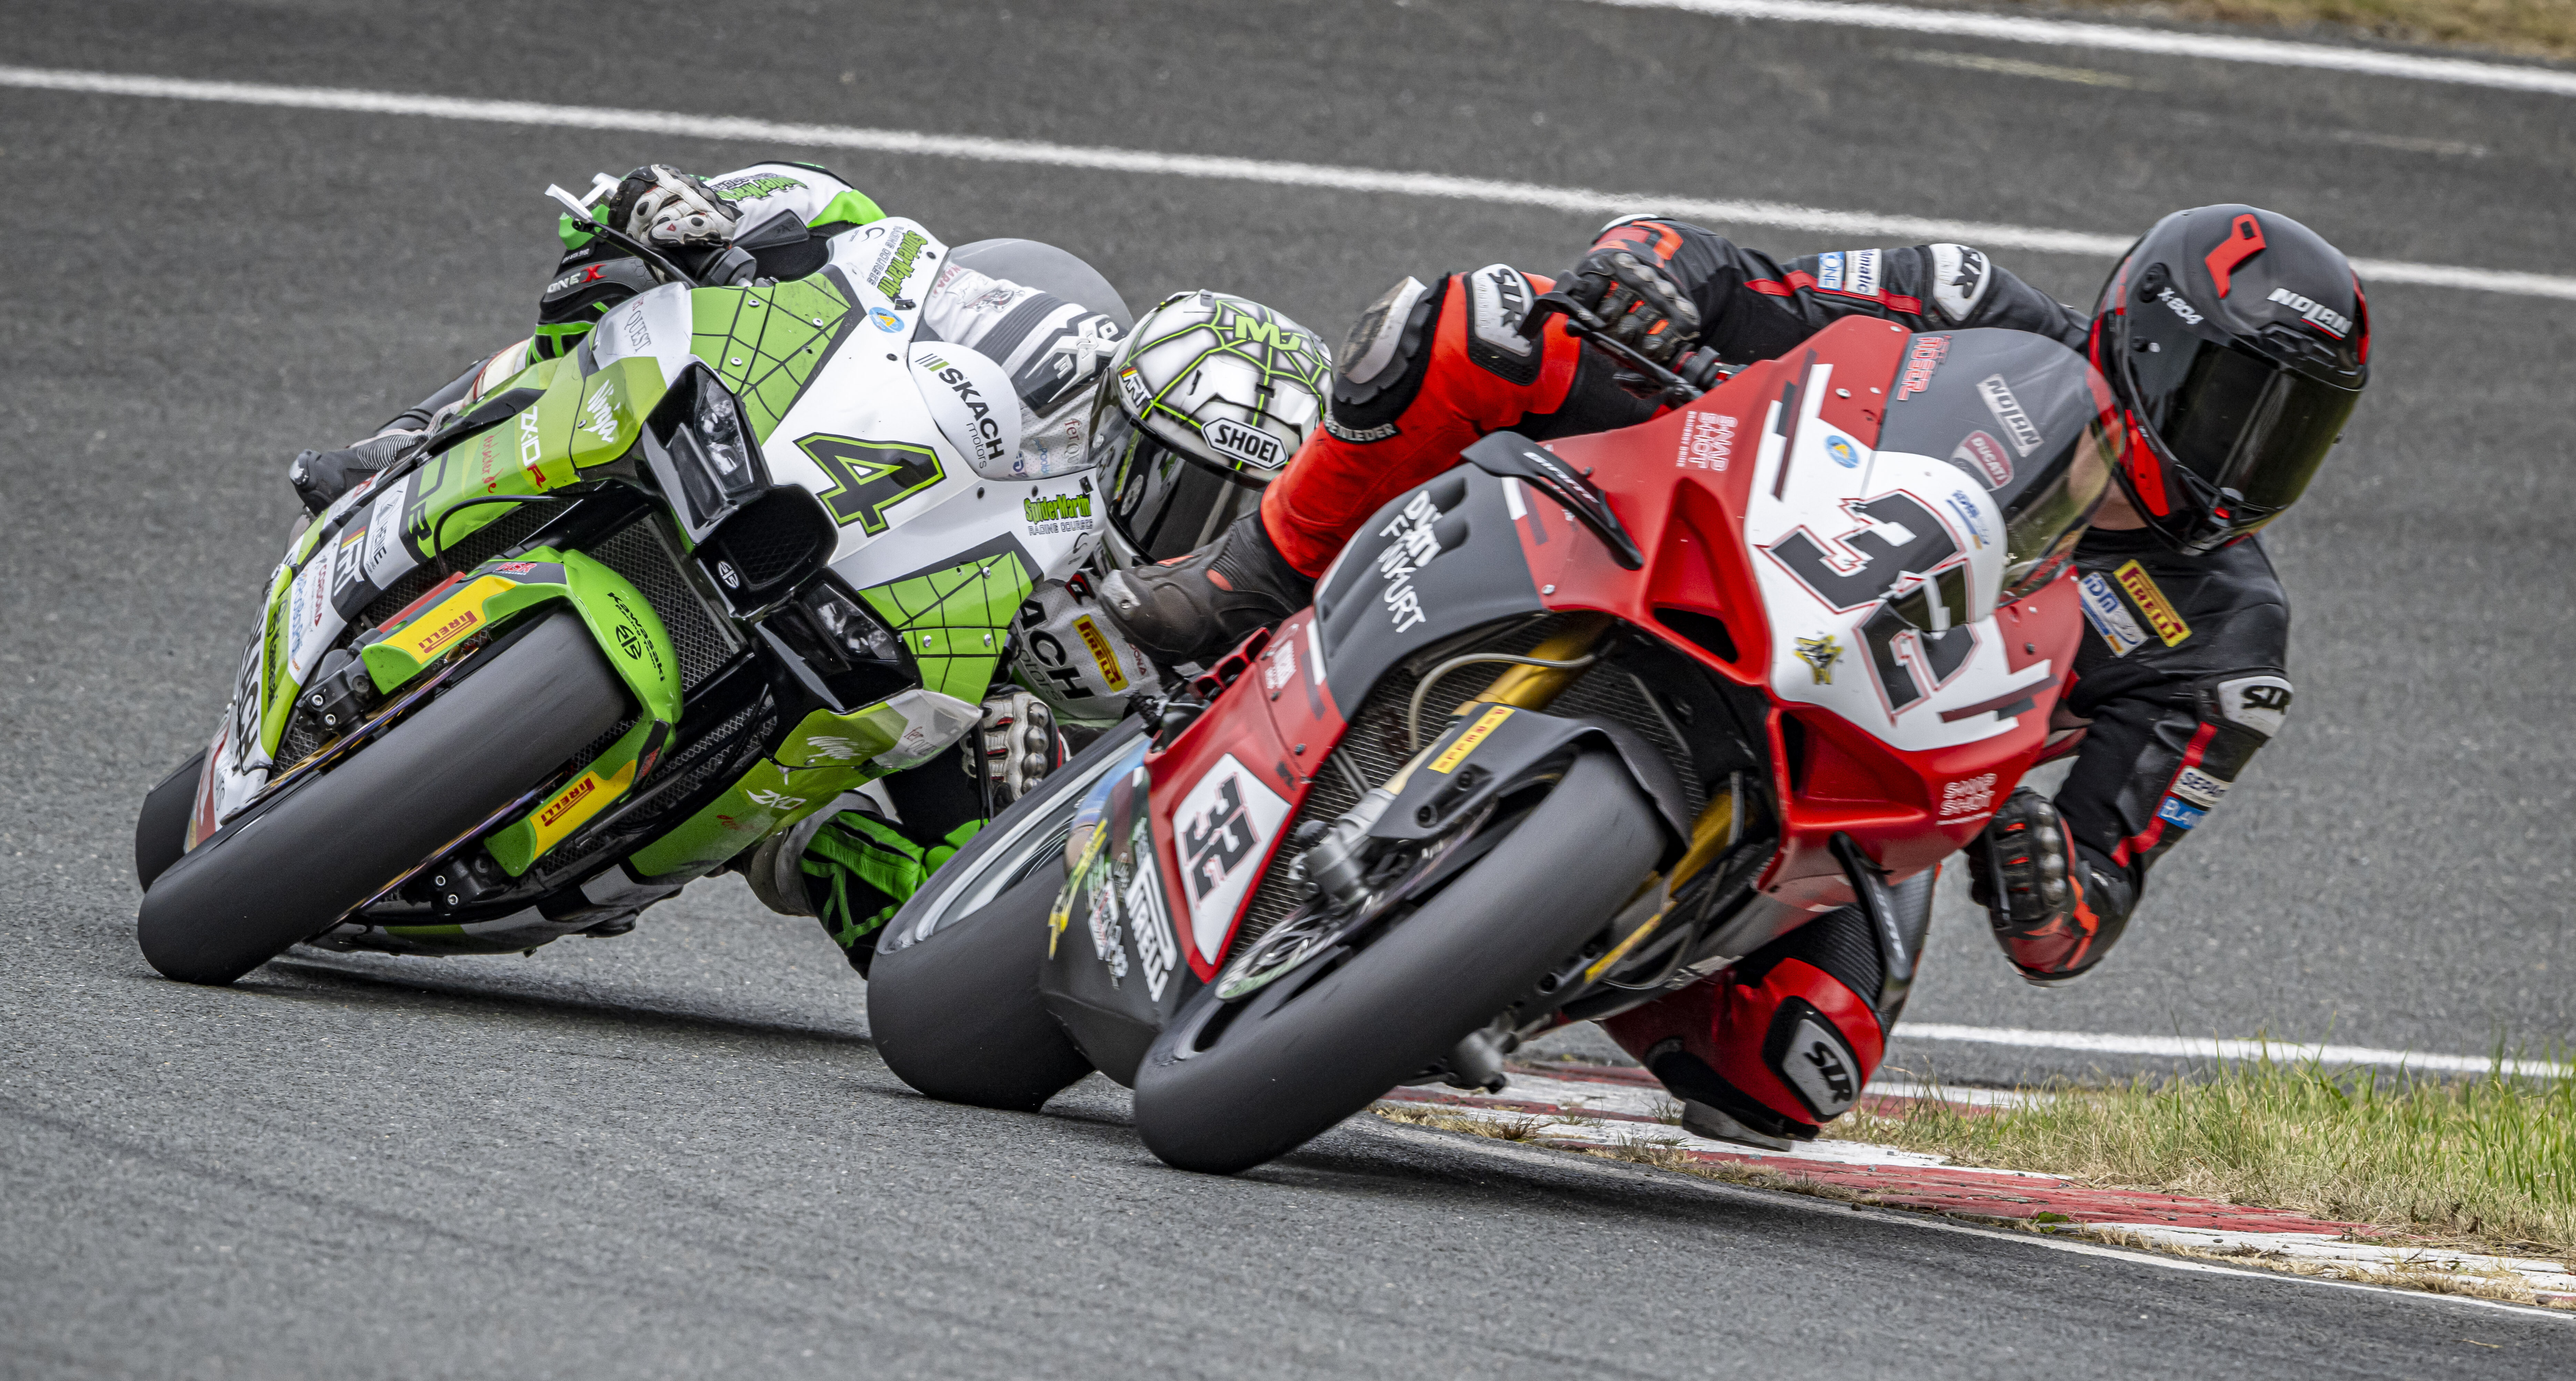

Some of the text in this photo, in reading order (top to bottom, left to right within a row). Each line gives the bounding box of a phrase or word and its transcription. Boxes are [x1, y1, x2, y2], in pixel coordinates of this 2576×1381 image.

[2267, 288, 2353, 339] NOLAN
[1896, 337, 1944, 401] MOSER
[938, 368, 1005, 460] SKACH
[1986, 380, 2040, 445] NOLAN
[966, 422, 988, 469] motors
[1214, 424, 1278, 464] SHOEI
[1971, 436, 2008, 482] DUCATI
[792, 432, 947, 538] 4
[1024, 494, 1092, 525] SpiderMartin
[373, 521, 388, 565] HEINE
[495, 562, 537, 573] HSR
[418, 610, 478, 654] PIRELLI
[615, 604, 641, 636] Racing
[1753, 488, 1982, 728] 32
[2121, 567, 2183, 639] PIRELLI
[607, 592, 665, 682] Kawasaki
[1019, 599, 1094, 699] ACH
[1077, 620, 1122, 684] PIRELLI
[1021, 649, 1064, 702] otors
[541, 777, 596, 827] PIRELLI
[1181, 771, 1262, 910] 32
[1123, 852, 1177, 1002] PIRELLI
